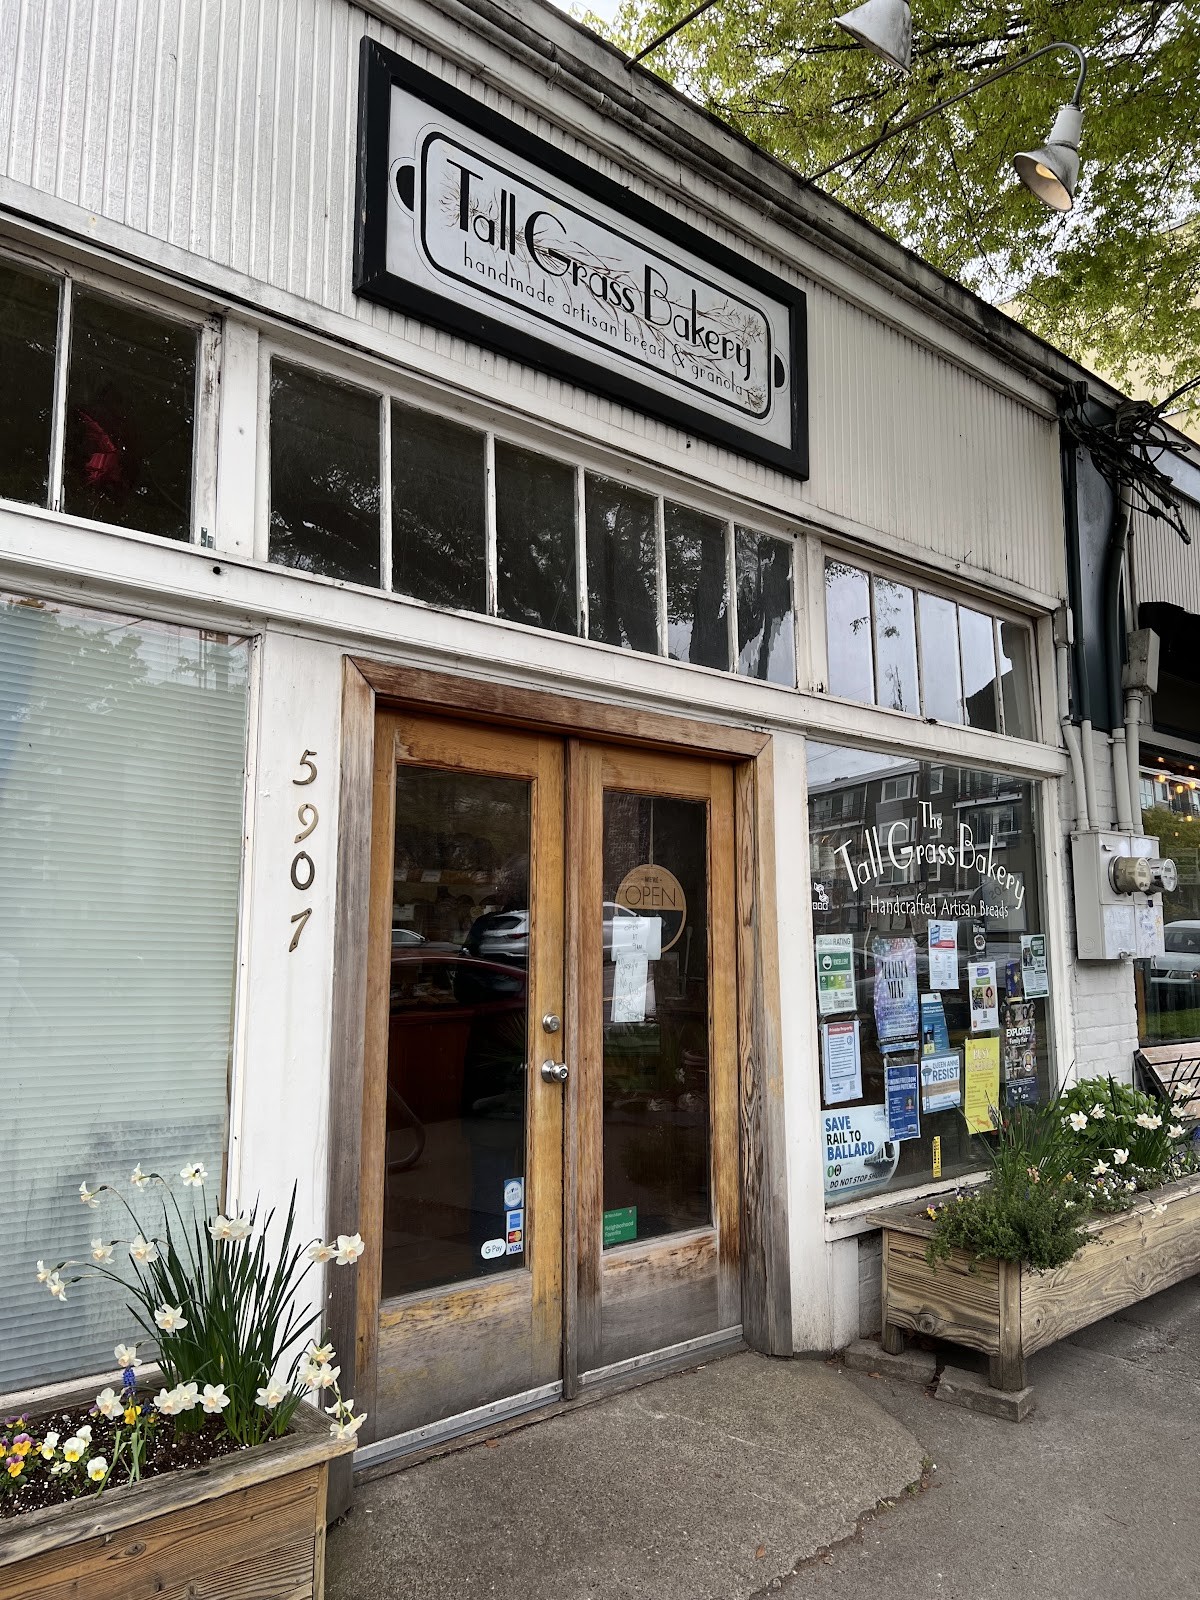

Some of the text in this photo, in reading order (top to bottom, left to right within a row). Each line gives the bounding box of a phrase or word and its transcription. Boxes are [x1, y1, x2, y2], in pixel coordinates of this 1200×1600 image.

[446, 158, 752, 382] Tall Grass Bakery
[464, 241, 744, 396] handmade artisan bread & granola
[919, 800, 943, 830] The
[289, 749, 319, 953] 5907
[834, 821, 1026, 910] Tall Grass Bakery
[625, 885, 676, 907] OPEN
[870, 893, 1009, 919] Handcrafted Artisan Breads
[932, 1061, 947, 1070] QUEEN
[947, 1059, 959, 1067] ANNE
[932, 1066, 959, 1082] RESIST
[825, 1115, 852, 1133] SAVE
[826, 1129, 862, 1146] RAIL TO
[827, 1140, 875, 1161] BALLARD
[829, 1180, 839, 1189] DO
[839, 1177, 853, 1187] NOT
[852, 1174, 869, 1184] STOP
[509, 1244, 522, 1253] VISA
